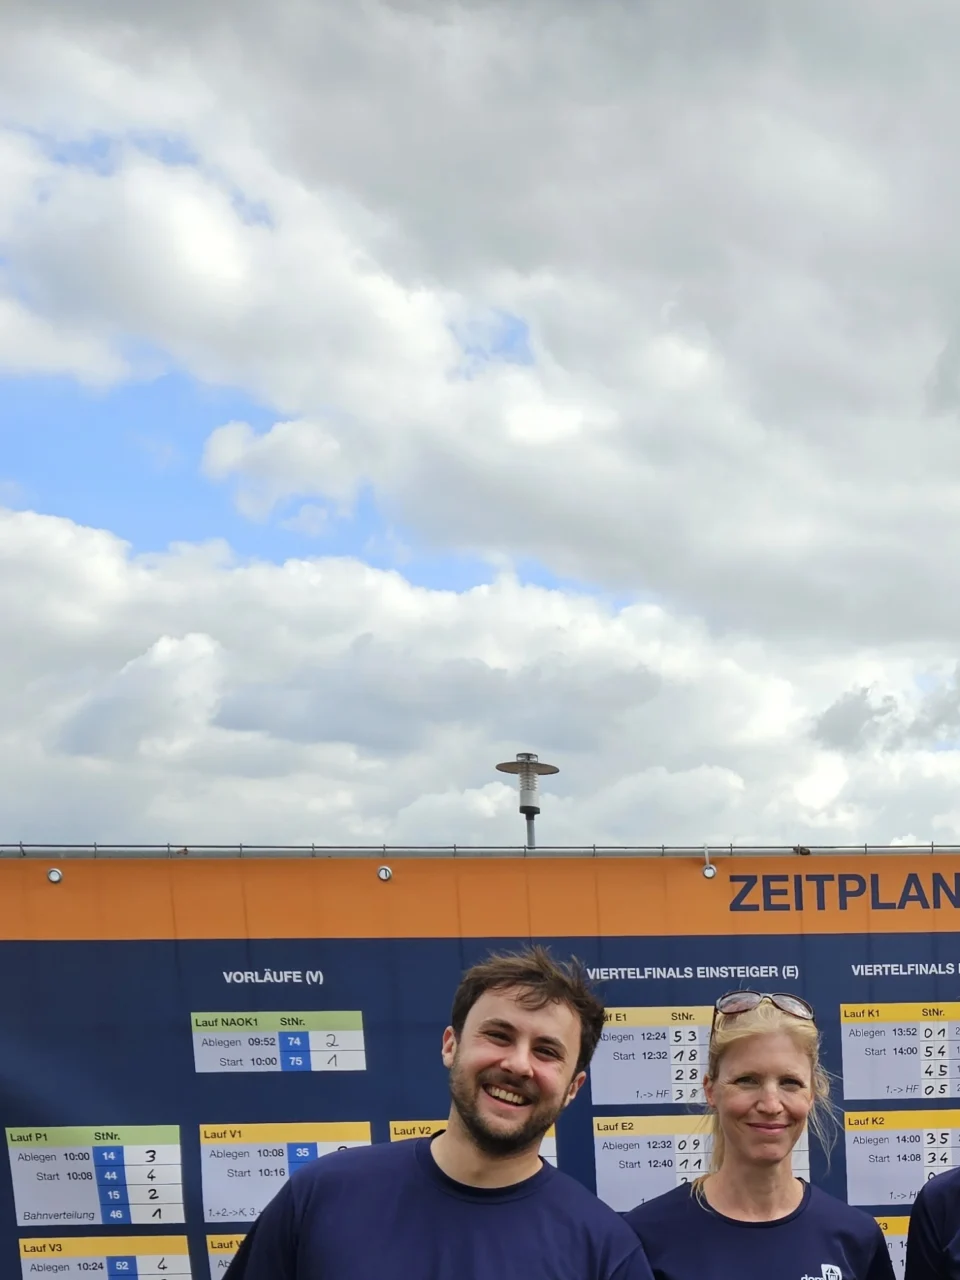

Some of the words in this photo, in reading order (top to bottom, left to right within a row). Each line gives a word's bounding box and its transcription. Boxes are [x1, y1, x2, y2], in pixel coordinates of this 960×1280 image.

[587, 967, 693, 980] VIERTELFINALS
[696, 966, 779, 979] EINSTEIGER
[781, 965, 799, 980] (E)
[851, 963, 955, 976] VIERTELFINALS
[223, 969, 302, 984] VORLÄUFE
[306, 971, 323, 985] (V)
[844, 1009, 866, 1018] Lauf
[867, 1009, 880, 1017] K1
[921, 1008, 945, 1017] StNr.
[195, 1018, 218, 1026] Lauf
[221, 1018, 258, 1026] NAOK1
[280, 1017, 305, 1026] StNr.
[848, 1029, 886, 1038] Ablegen
[892, 1028, 917, 1036] 13:52
[201, 1038, 241, 1047] Ablegen
[248, 1038, 275, 1046] 09:52
[288, 1037, 301, 1045] 74
[326, 1034, 339, 1047] 2
[864, 1047, 887, 1056] Start
[893, 1047, 918, 1055] 14:00
[220, 1058, 243, 1066] Start
[250, 1057, 277, 1066] 10:00
[289, 1057, 302, 1065] 75
[327, 1054, 337, 1067] 1
[10, 1133, 33, 1142] Lauf
[35, 1133, 48, 1141] P1
[94, 1132, 121, 1141] StNr.
[17, 1153, 56, 1162] Ablegen
[63, 1153, 90, 1161] 10:00
[102, 1152, 116, 1160] 14
[145, 1150, 157, 1162] 3
[36, 1172, 60, 1181] Start
[66, 1172, 93, 1180] 10:08
[104, 1172, 117, 1180] 44
[147, 1169, 156, 1181] 4
[107, 1191, 120, 1199] 15
[148, 1189, 159, 1200] 2
[23, 1211, 95, 1221] Bahnverteilung
[110, 1210, 123, 1218] 46
[152, 1208, 161, 1219] 1
[23, 1244, 48, 1253] Lauf
[50, 1243, 63, 1252] V3
